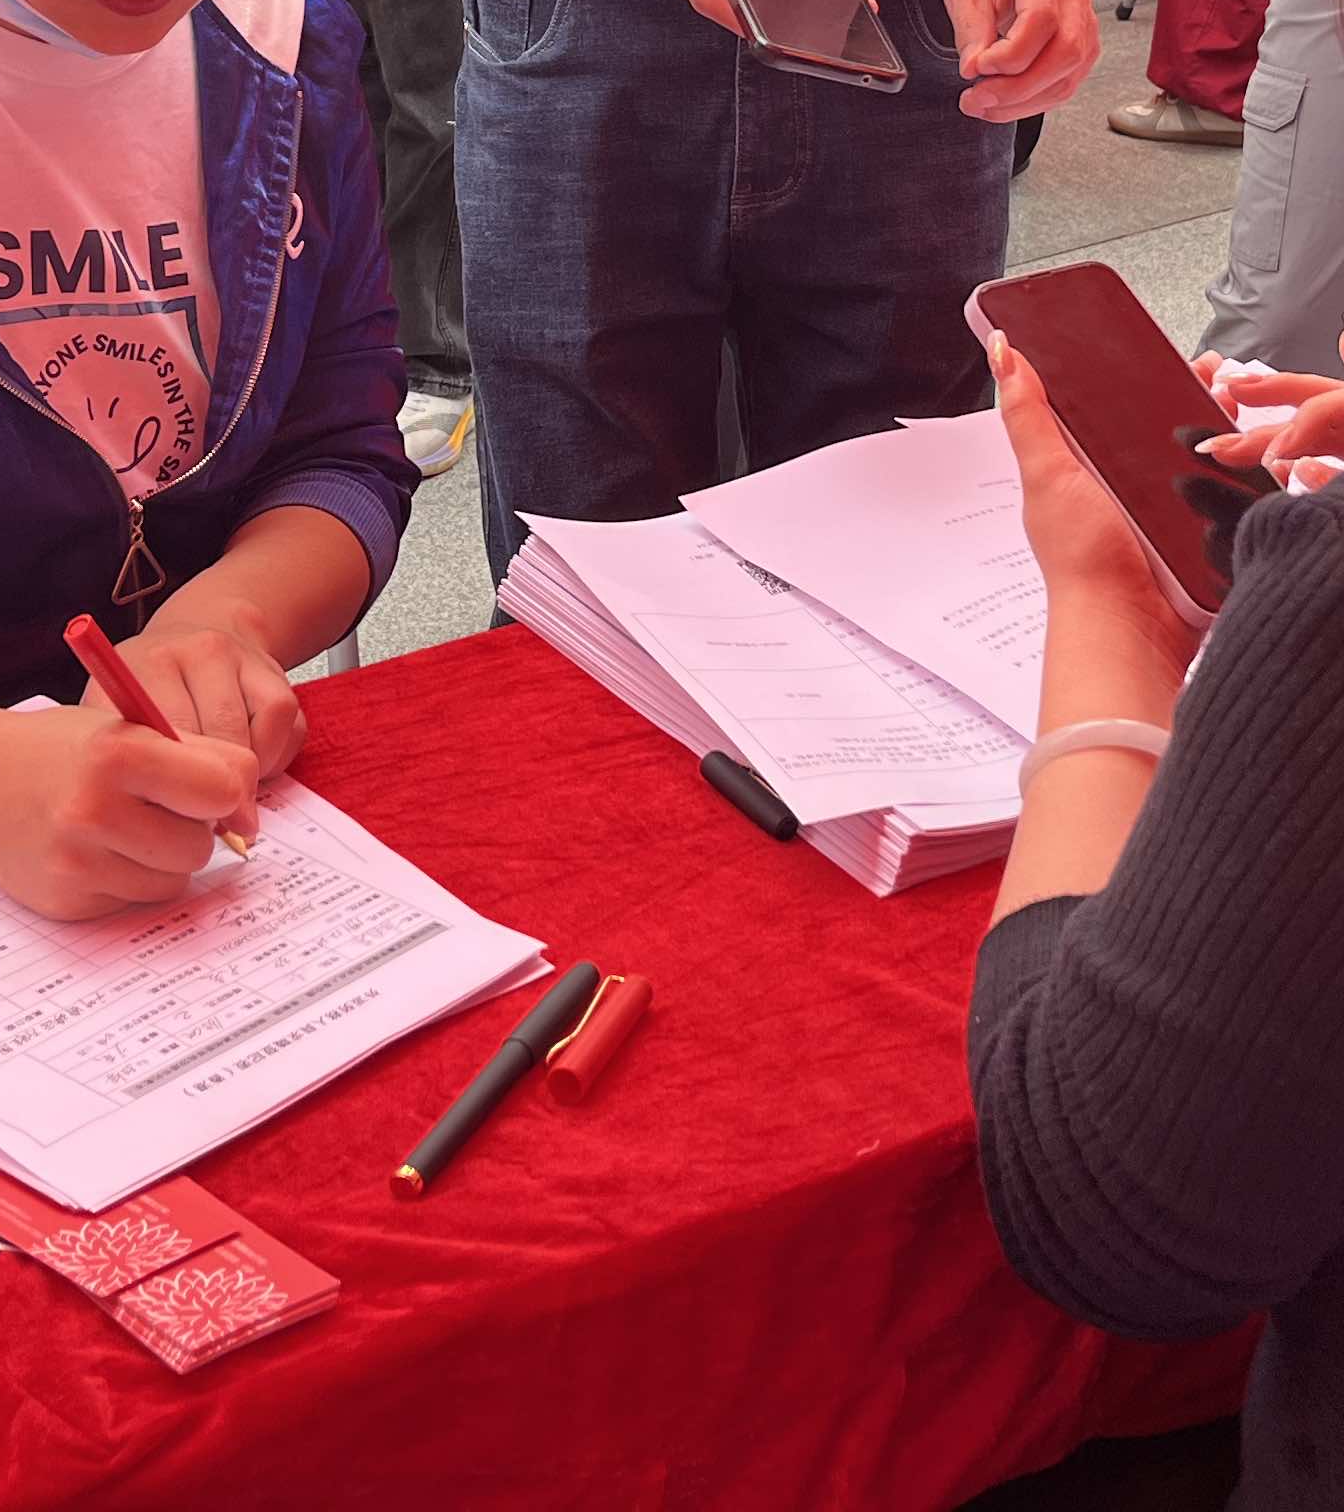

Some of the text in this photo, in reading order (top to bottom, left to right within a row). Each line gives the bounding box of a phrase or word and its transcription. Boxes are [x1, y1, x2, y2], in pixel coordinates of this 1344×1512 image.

[34, 333, 195, 494] YONE SMILES IN THE SA
